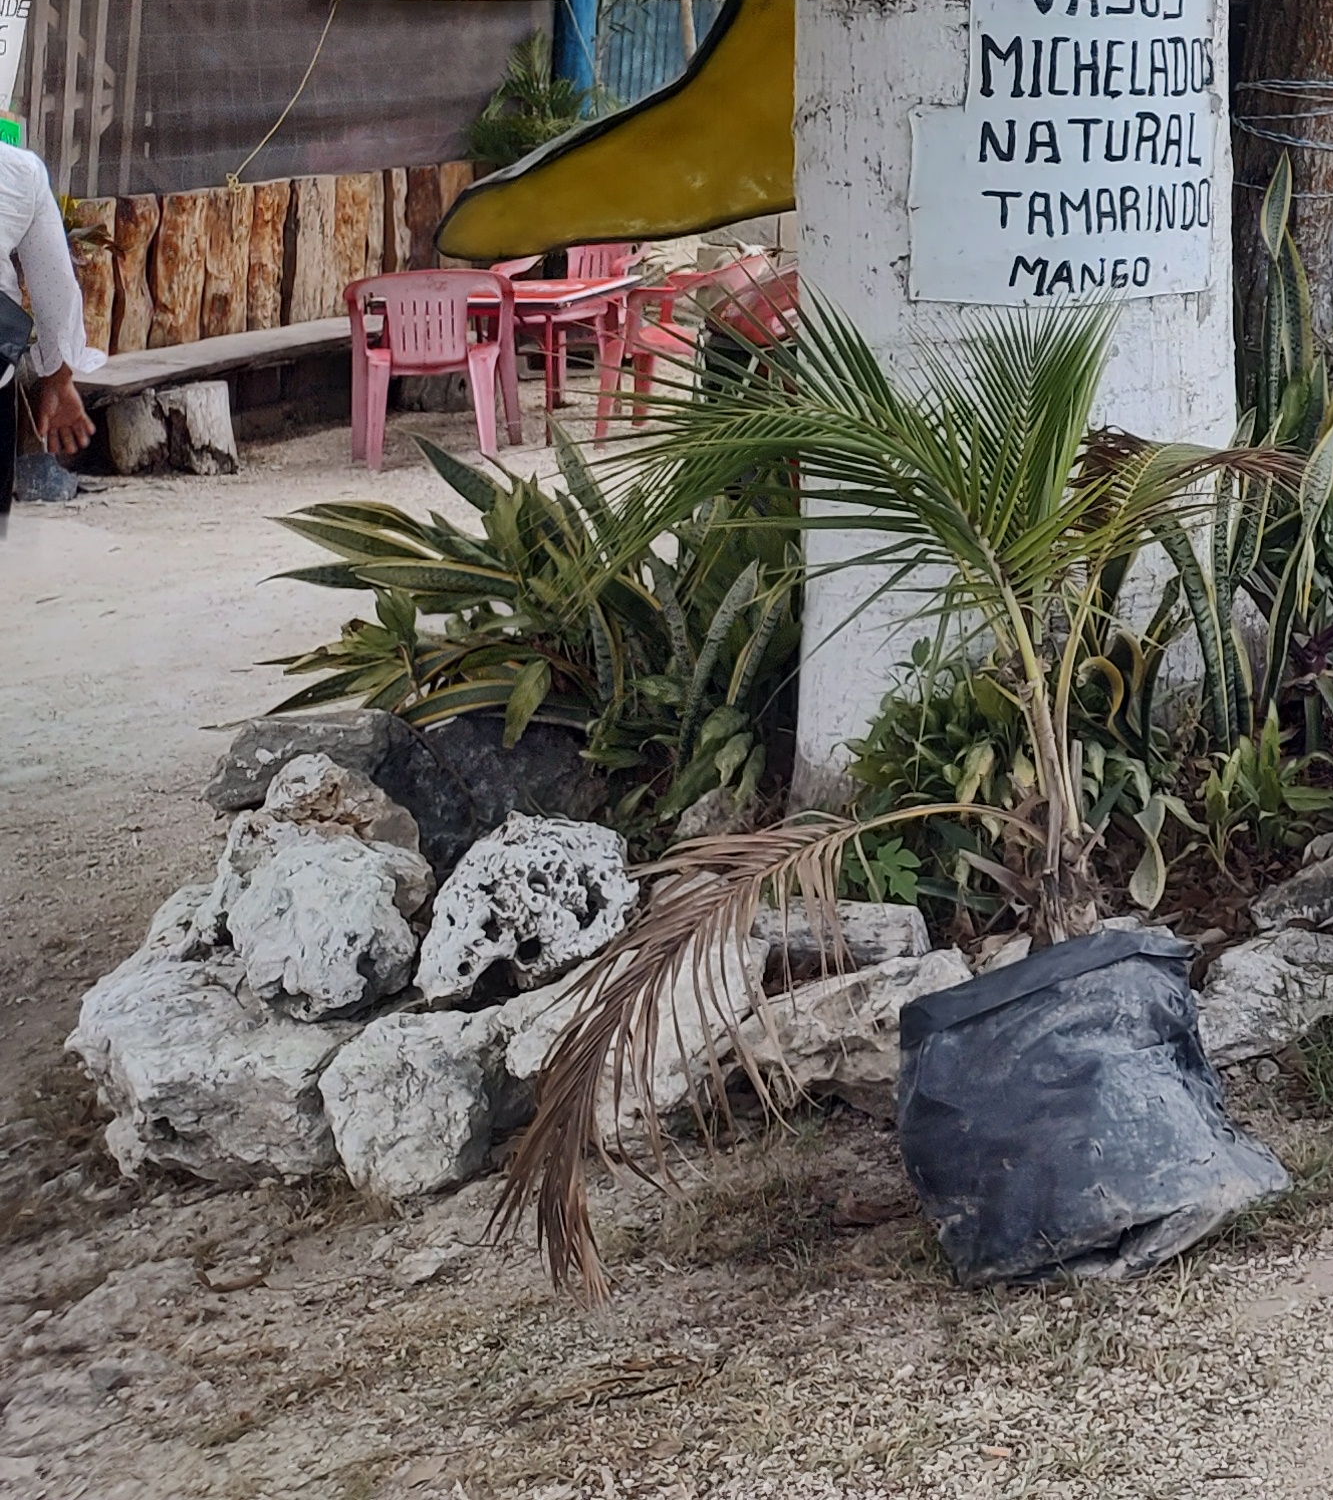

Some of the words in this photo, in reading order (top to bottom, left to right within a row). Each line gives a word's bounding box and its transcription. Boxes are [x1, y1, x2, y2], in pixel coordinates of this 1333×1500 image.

[980, 33, 1215, 98] MICHELADOS
[978, 111, 1203, 168] NATURAL
[981, 177, 1212, 238] TAMARINDO
[1008, 255, 1151, 297] MANGO
